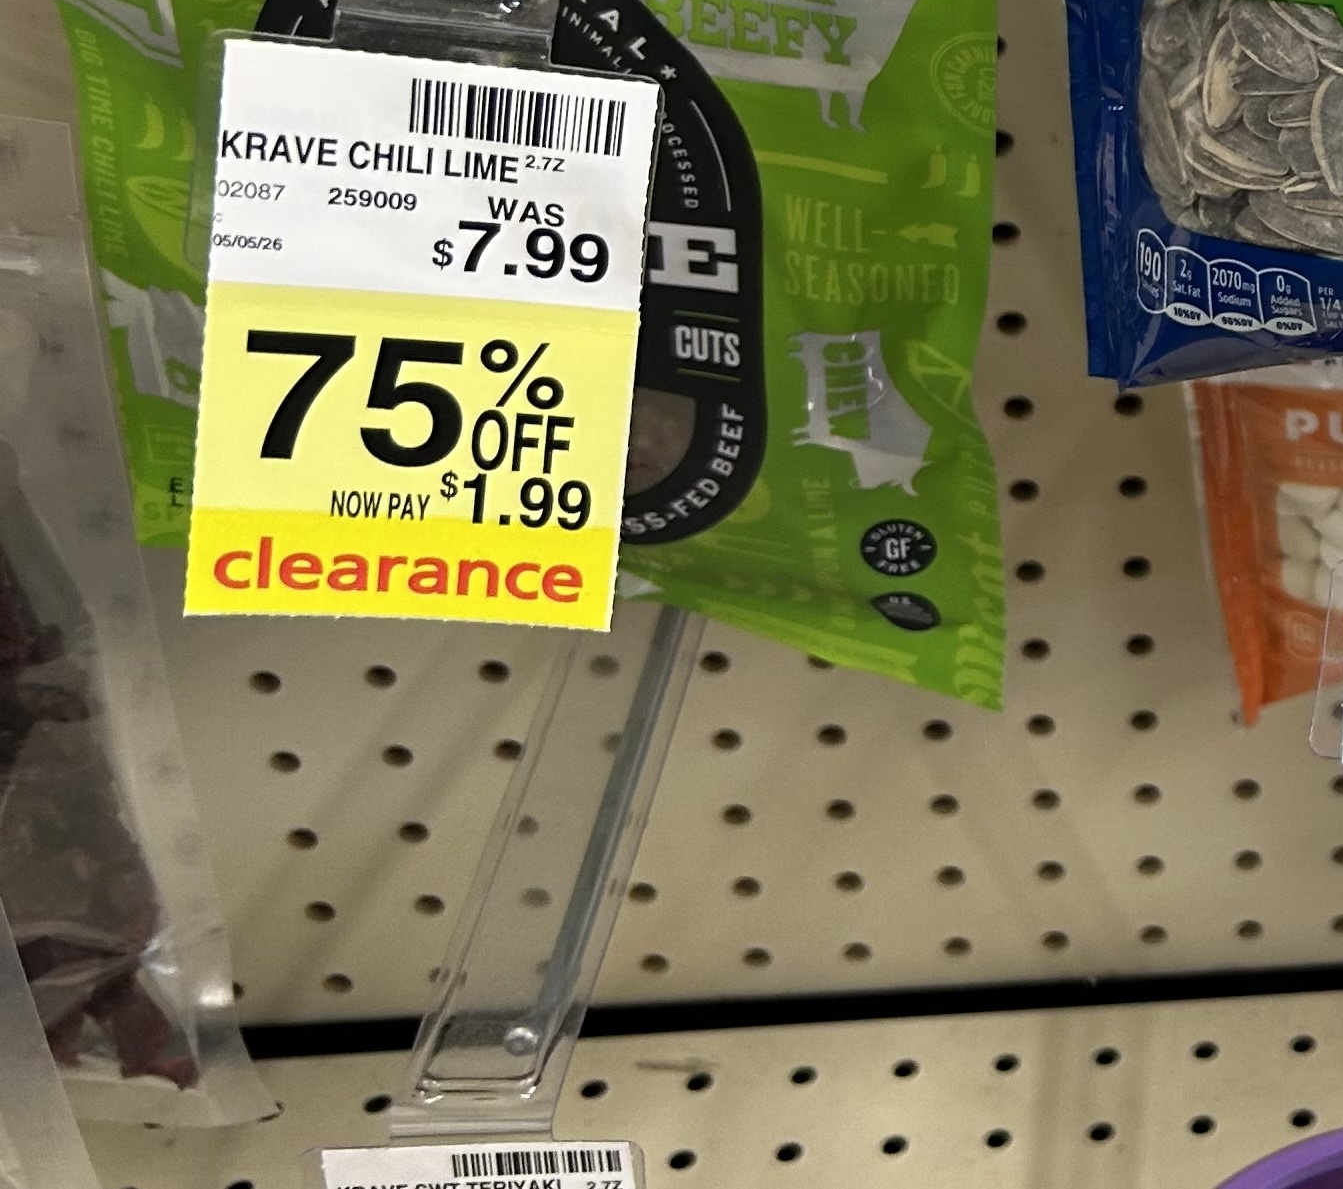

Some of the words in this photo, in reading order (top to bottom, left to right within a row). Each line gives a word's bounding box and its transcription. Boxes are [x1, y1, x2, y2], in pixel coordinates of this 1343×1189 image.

[220, 129, 338, 167] KRAVE
[348, 141, 434, 175] CHILI
[444, 149, 520, 184] LIME
[525, 154, 566, 173] 2.7Z
[327, 186, 418, 212] 259009
[487, 196, 565, 227] WAS
[785, 195, 870, 255] WELL
[213, 233, 284, 253] 05/05/26
[432, 219, 610, 284] $7.99
[783, 250, 963, 307] SEASONED
[674, 324, 743, 369] CUTS
[471, 409, 576, 474] OFF
[712, 402, 746, 479] BEEF
[330, 489, 383, 519] NOW
[388, 492, 431, 521] PAY
[440, 471, 592, 531] $1.99
[213, 536, 584, 603] clearance
[884, 538, 914, 563] GF
